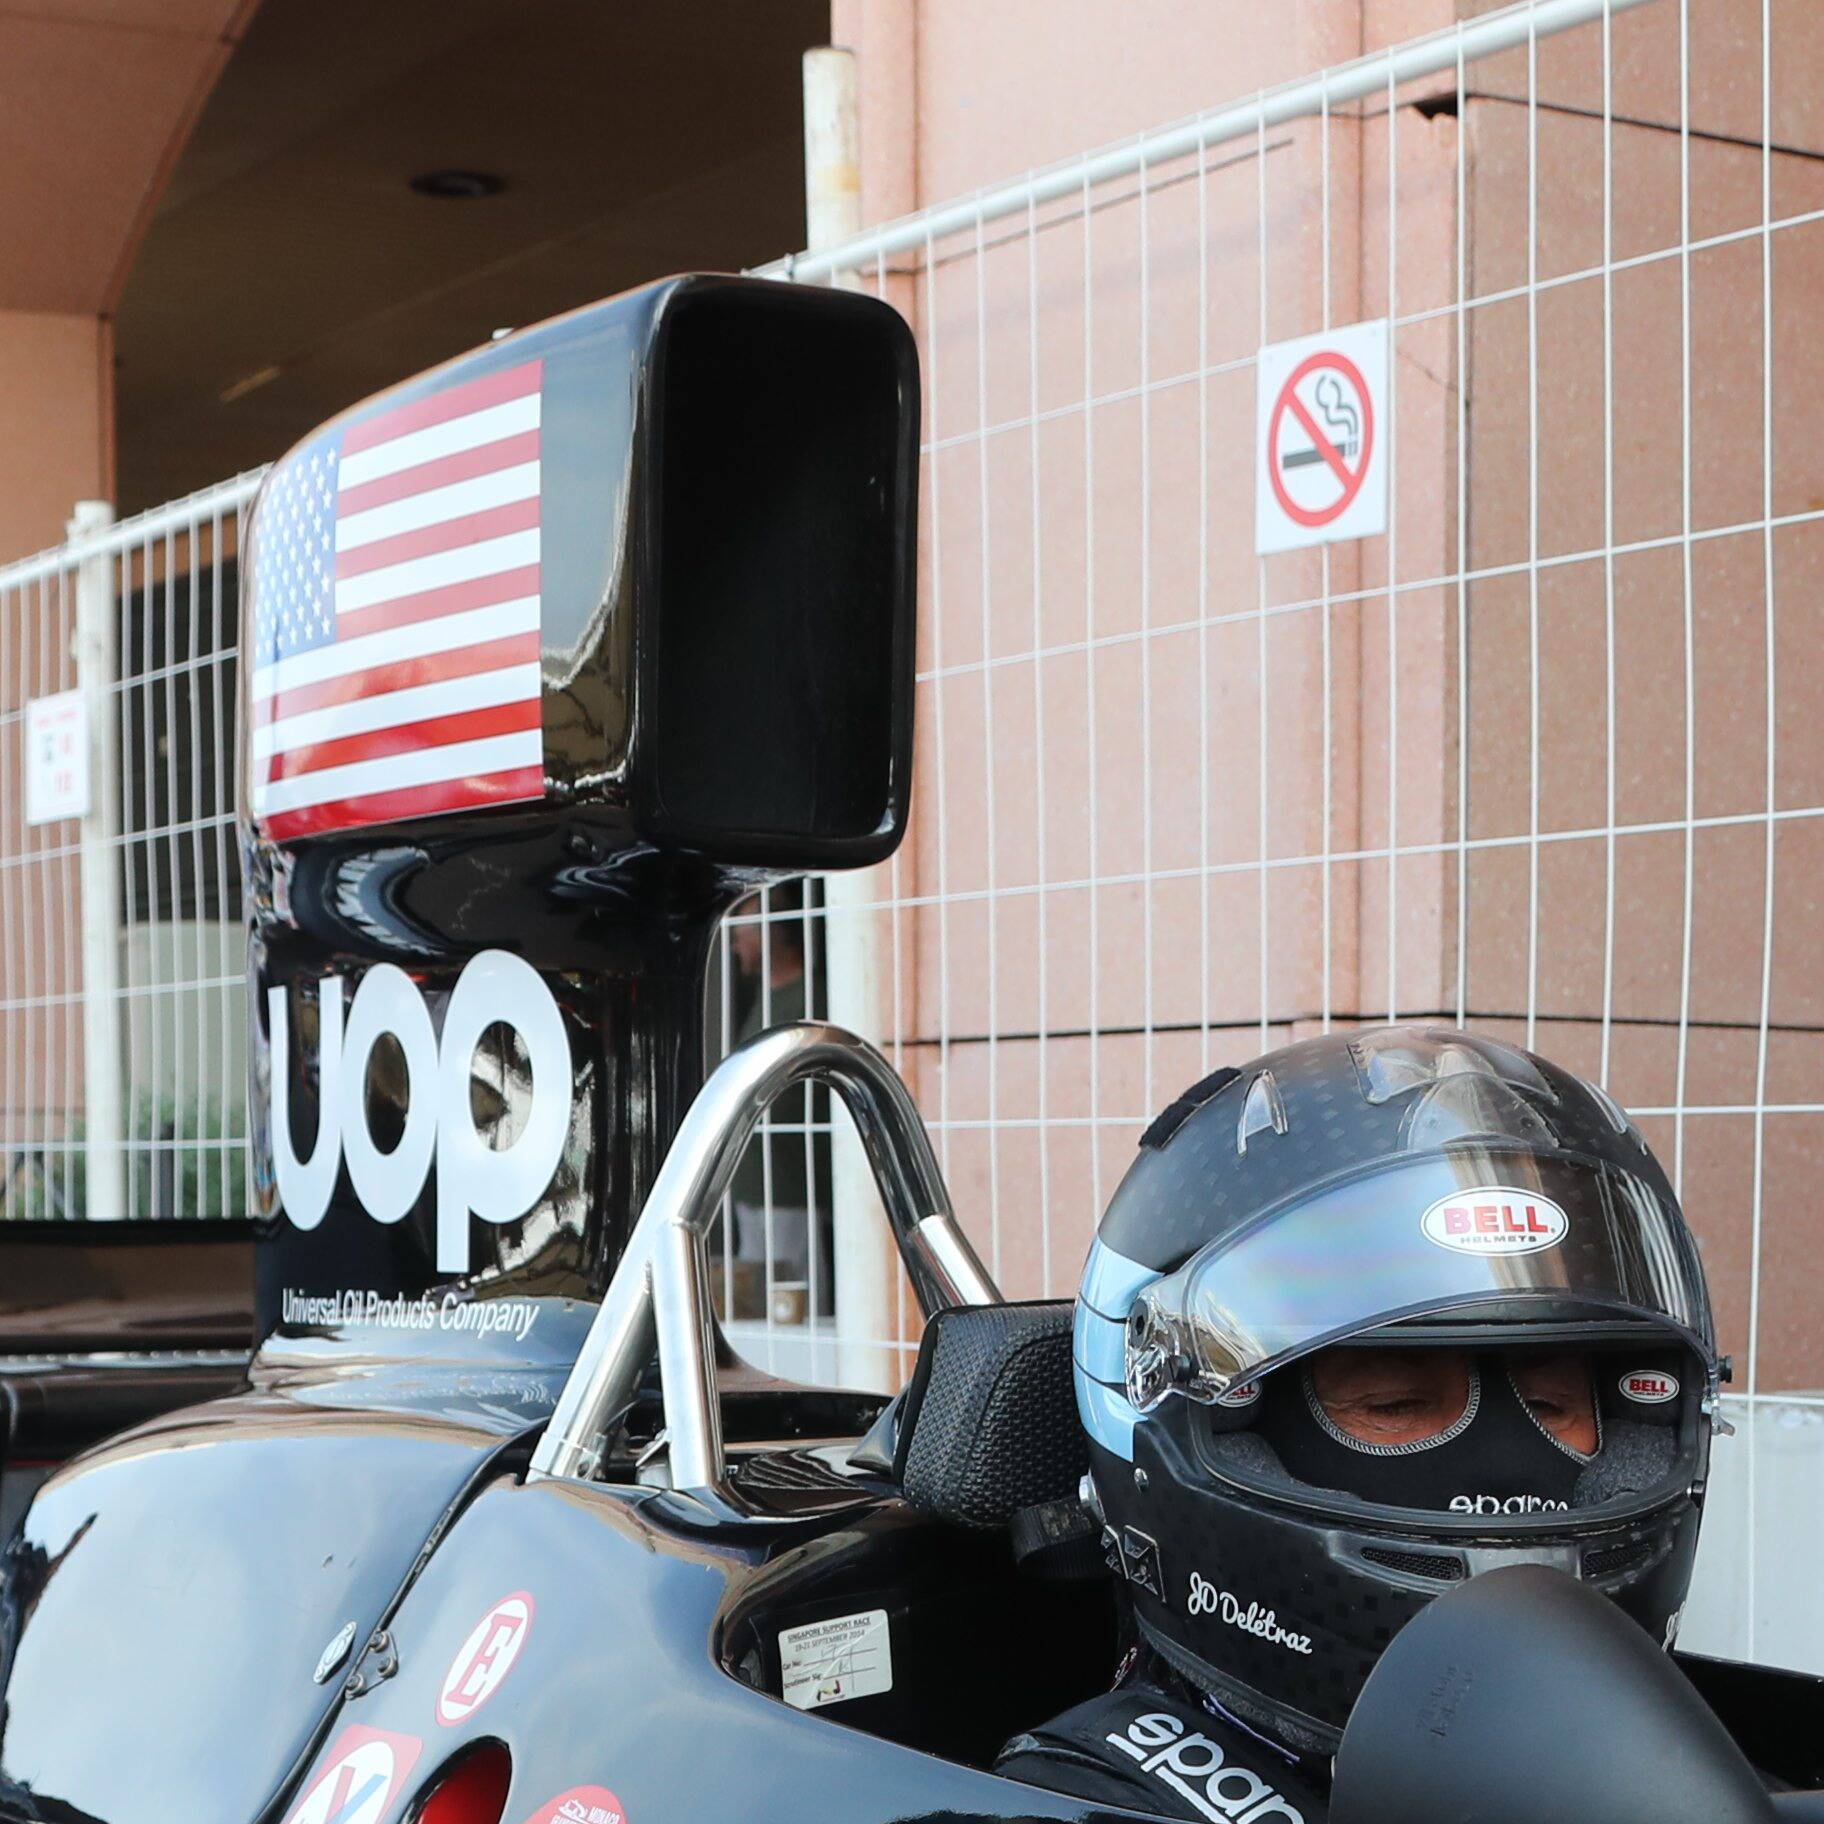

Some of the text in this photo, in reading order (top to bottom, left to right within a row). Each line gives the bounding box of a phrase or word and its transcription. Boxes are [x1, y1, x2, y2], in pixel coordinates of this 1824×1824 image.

[267, 948, 574, 1274] uop
[1443, 1206, 1549, 1235] BELL
[1460, 1235, 1537, 1244] HELMETS
[281, 1288, 540, 1342] Universal Oil Products Company
[1629, 1378, 1669, 1393] BELL
[1219, 1591, 1313, 1655] Delétraz
[444, 1613, 524, 1707] E
